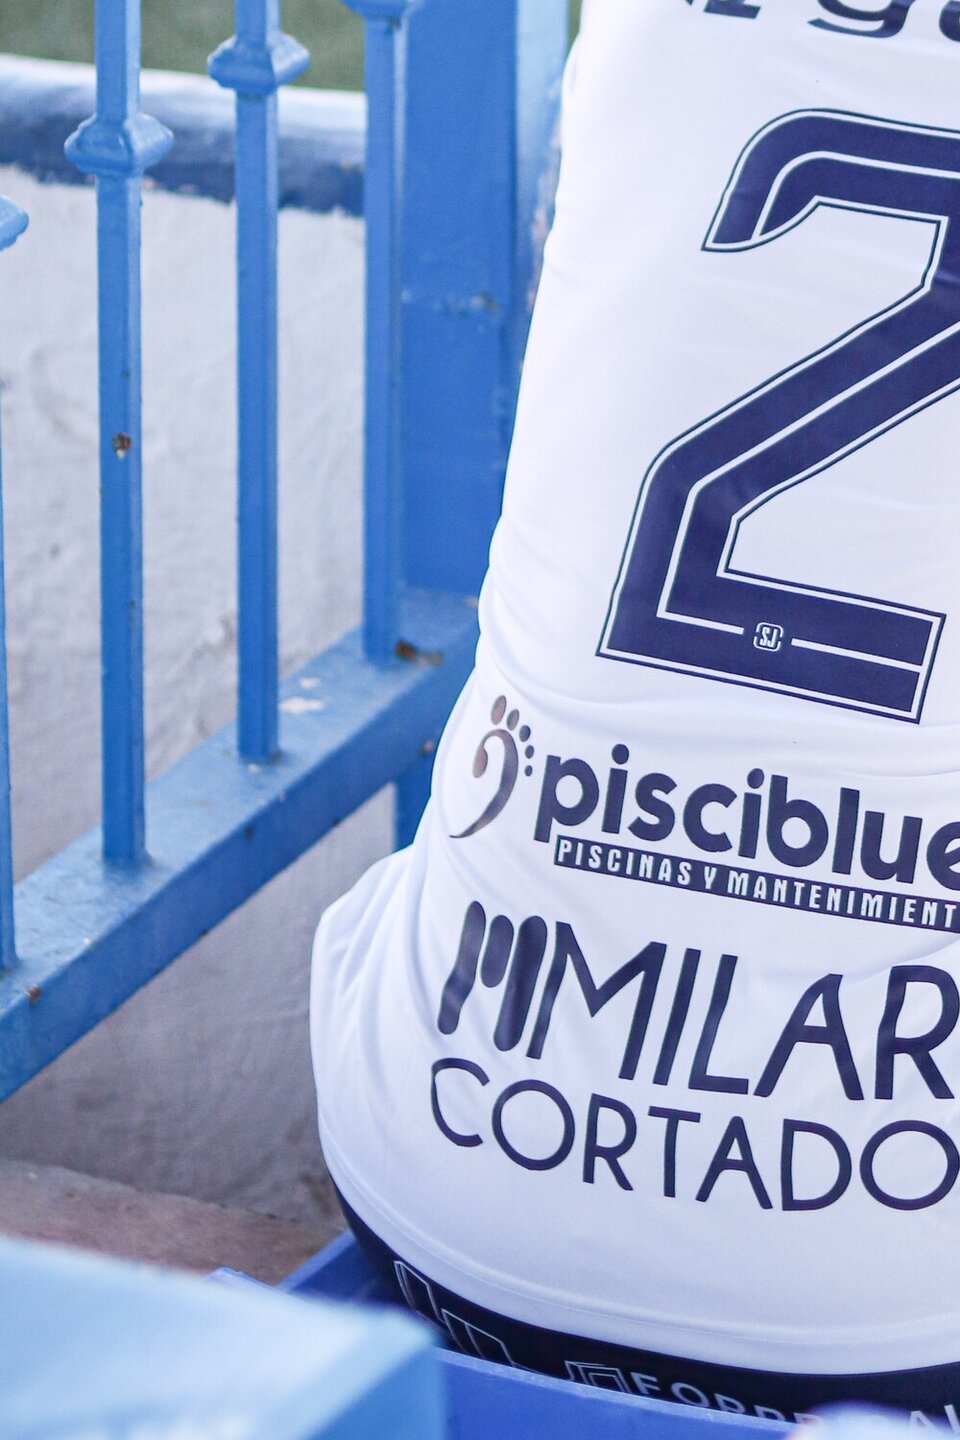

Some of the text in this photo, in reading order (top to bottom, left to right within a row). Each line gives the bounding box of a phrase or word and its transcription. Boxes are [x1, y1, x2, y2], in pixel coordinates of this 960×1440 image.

[557, 839, 692, 886] PISCINAS
[703, 866, 718, 888] Y
[525, 921, 960, 1101] MILAR
[431, 1057, 960, 1212] CORTADO
